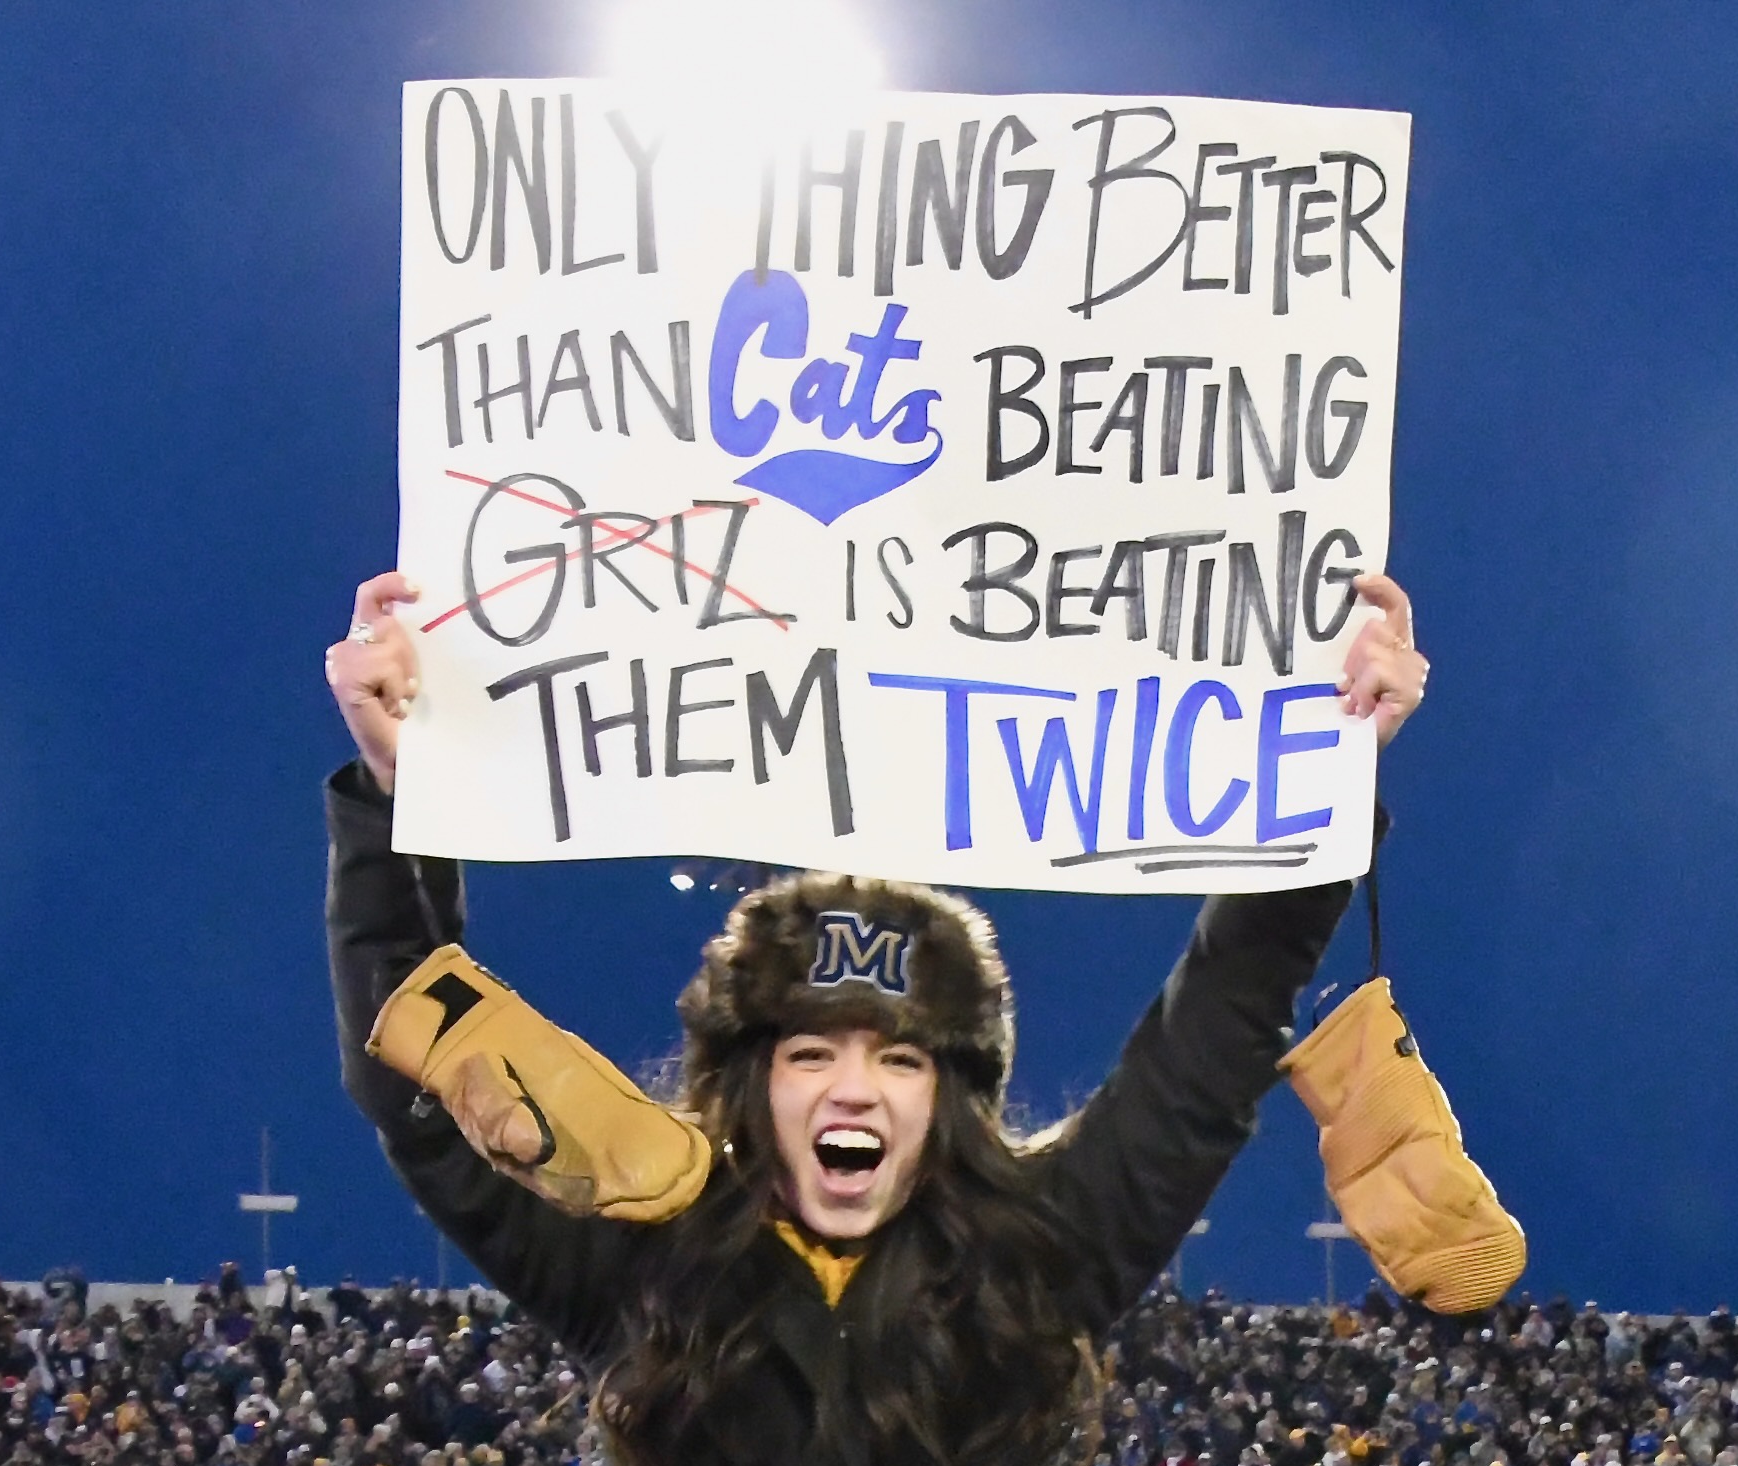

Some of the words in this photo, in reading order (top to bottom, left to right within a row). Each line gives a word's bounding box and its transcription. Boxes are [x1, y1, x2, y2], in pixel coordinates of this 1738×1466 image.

[423, 87, 663, 276] ONLY
[1068, 105, 1395, 319] BETTER
[417, 315, 698, 448] THAN
[708, 270, 944, 464] Cats
[973, 345, 1369, 494] BEATING
[462, 472, 797, 647] GRIZ
[845, 536, 915, 628] IS
[941, 509, 1361, 675] BEATING
[488, 648, 856, 843] THEM
[867, 672, 1341, 856] TWICE
[809, 911, 913, 997] M
